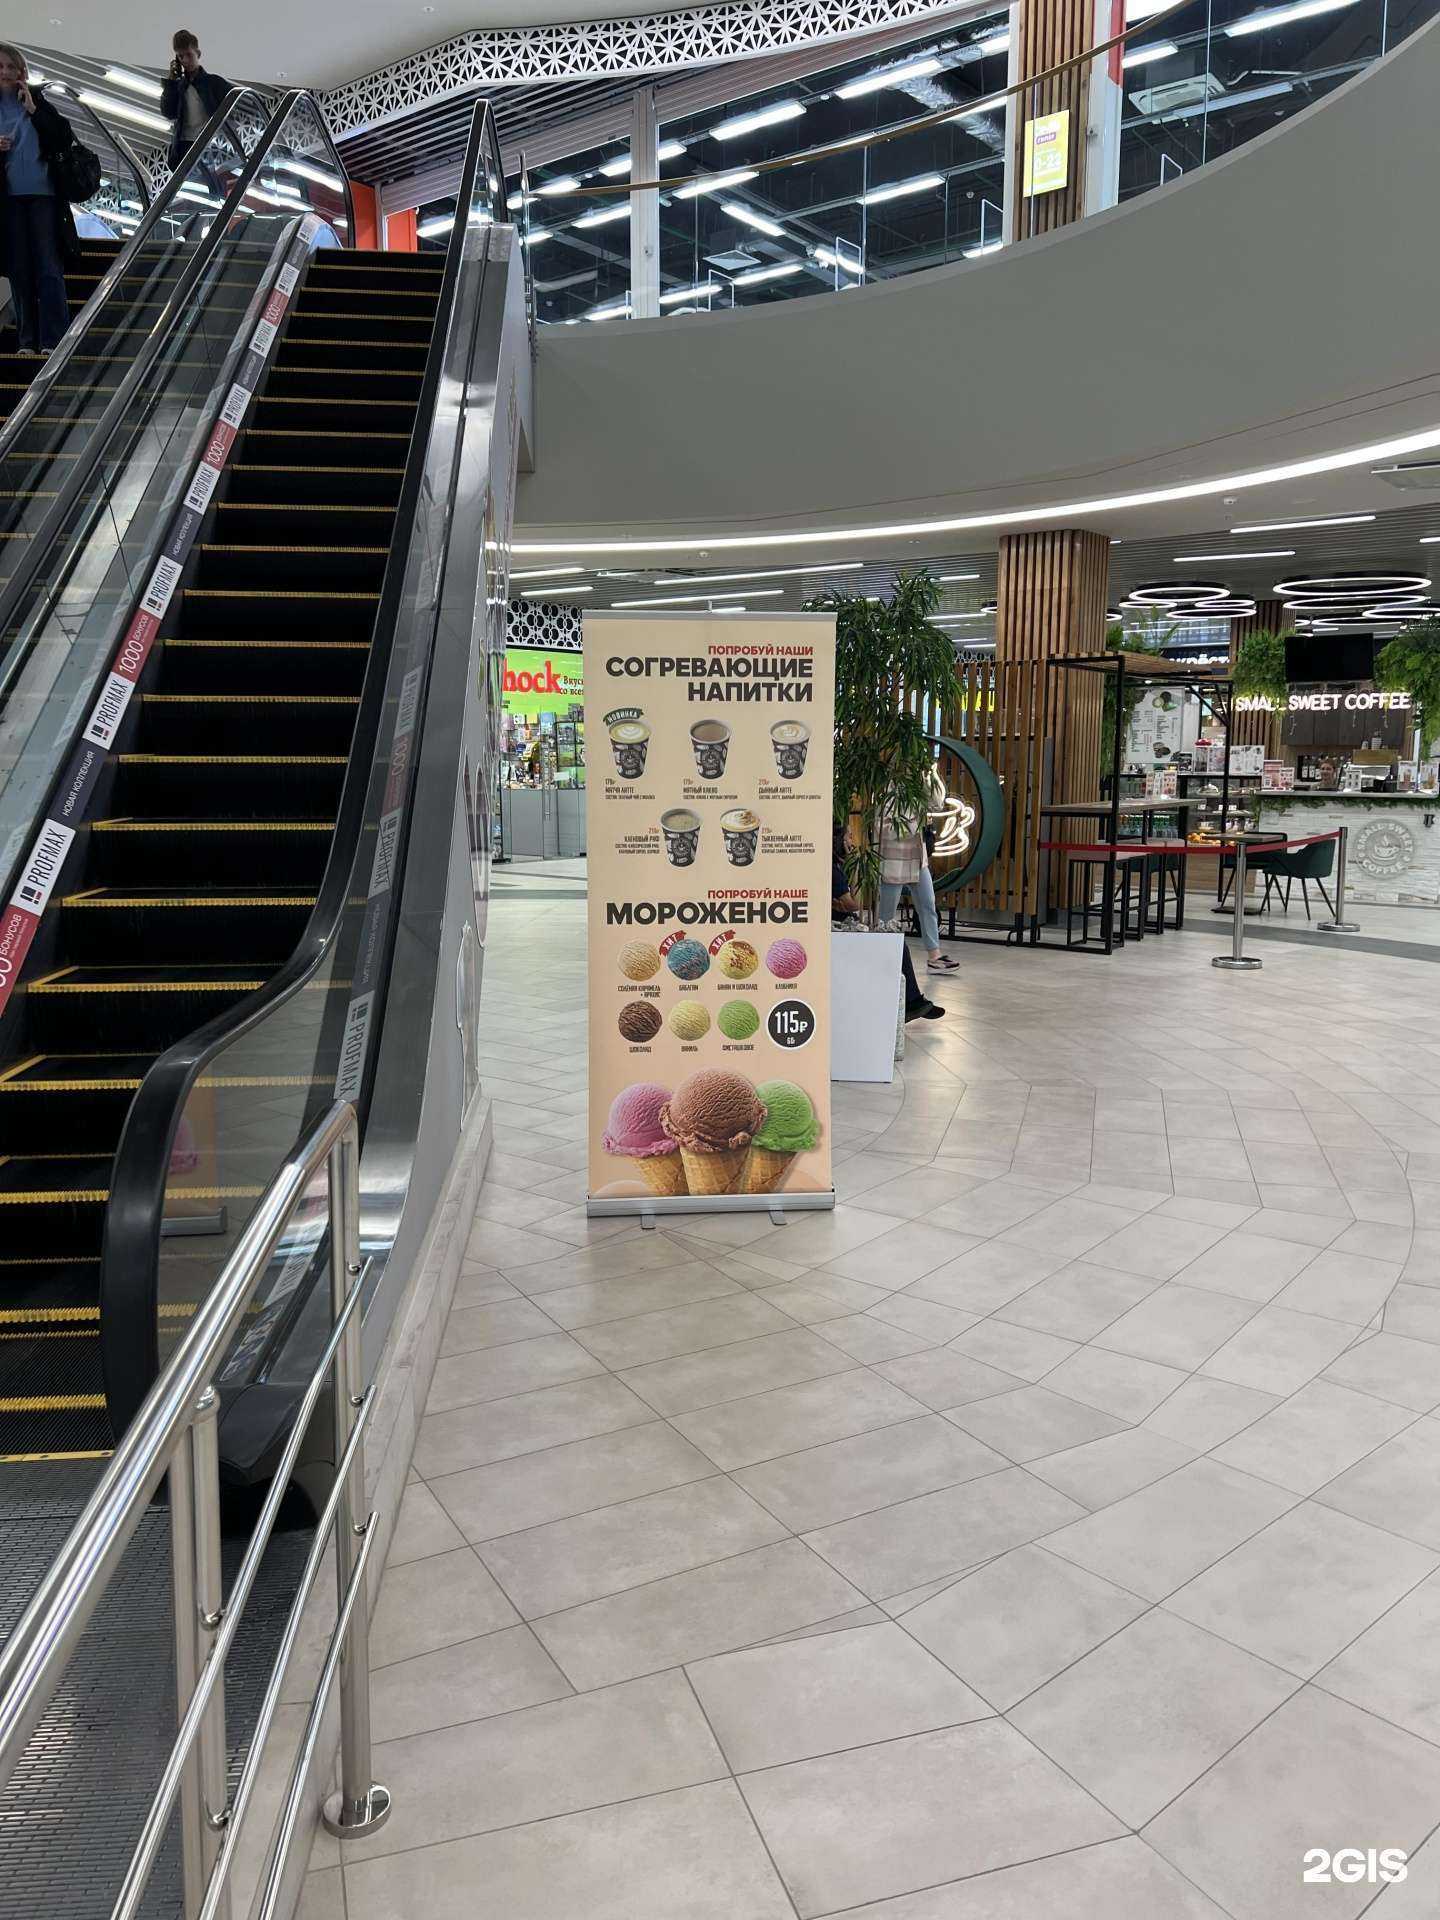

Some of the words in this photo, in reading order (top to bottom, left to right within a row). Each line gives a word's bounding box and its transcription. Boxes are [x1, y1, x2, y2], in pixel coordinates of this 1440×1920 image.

[207, 440, 225, 465] 1000
[192, 467, 215, 501] PROFMAX
[151, 561, 177, 601] PROFMAX
[119, 640, 144, 674] 1000
[708, 644, 774, 656] ПОПРОБУЙ
[776, 645, 814, 656] НАШИ
[605, 656, 813, 681] СОГРЕВАЮЩИЕ
[97, 680, 128, 727] PROFMAX
[688, 682, 813, 702] НАПИТКИ
[1288, 694, 1342, 711] SWEET
[1345, 692, 1412, 710] COFFEE
[607, 710, 638, 723] НОВИНКА
[62, 792, 79, 817] НОВАЯ
[73, 750, 96, 793] КОЛЛЕКЦИЯ
[27, 829, 67, 888] PROFMAX
[373, 831, 396, 889] PROFMAX
[1362, 859, 1405, 875] COFFEE
[708, 887, 772, 899] ПОПРОБУЙ
[774, 889, 809, 899] НАШЕ
[606, 901, 809, 925] МОРОЖЕНОЕ
[1, 913, 22, 956] БОНУСОВ
[661, 933, 679, 951] ХИТ
[712, 934, 727, 950] ХИТ
[736, 983, 758, 991] ШОКОЛАД
[339, 1023, 366, 1097] PROFMAX
